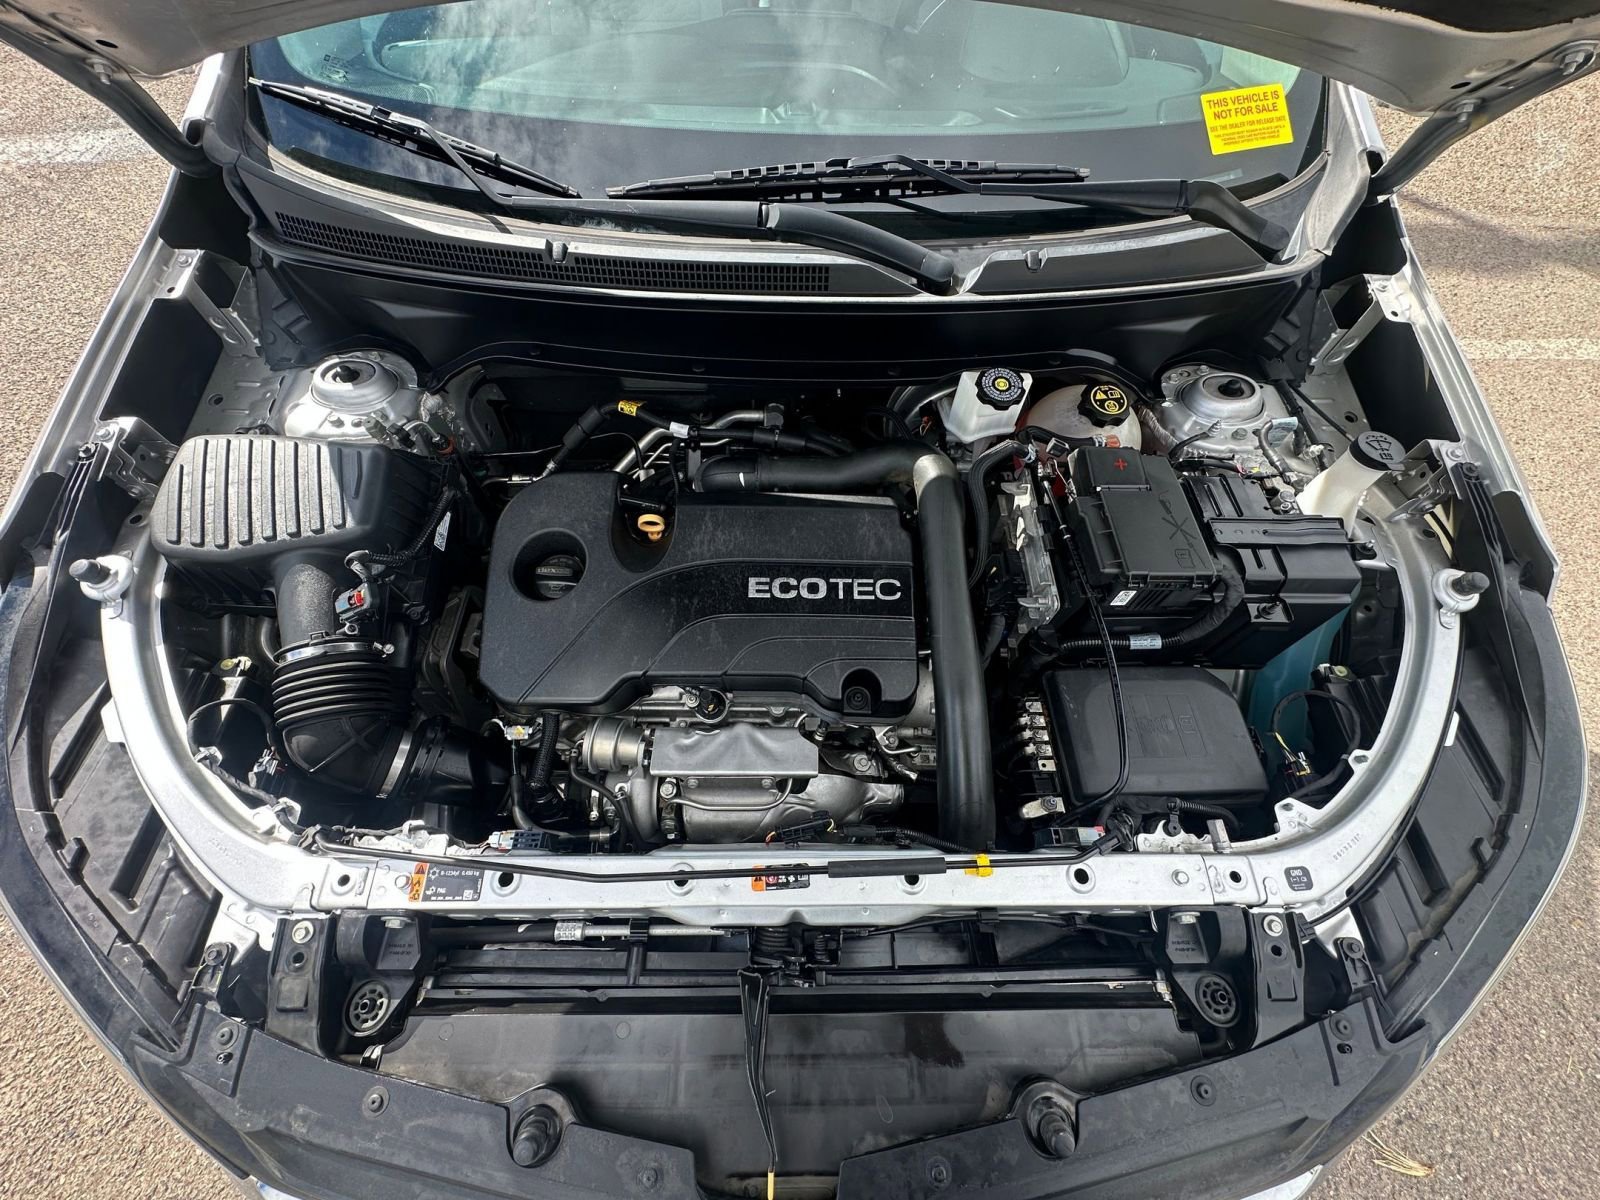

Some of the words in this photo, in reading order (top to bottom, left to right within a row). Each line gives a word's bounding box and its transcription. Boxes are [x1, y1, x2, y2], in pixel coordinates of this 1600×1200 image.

[1206, 98, 1228, 109] THIS
[1230, 92, 1269, 105] VEHICLE
[1271, 90, 1280, 100] IS
[1213, 109, 1232, 120] NOT
[1234, 106, 1254, 117] FOR
[1255, 102, 1278, 113] SALE
[1228, 121, 1246, 130] DEALER
[748, 577, 901, 600] ECOTEC
